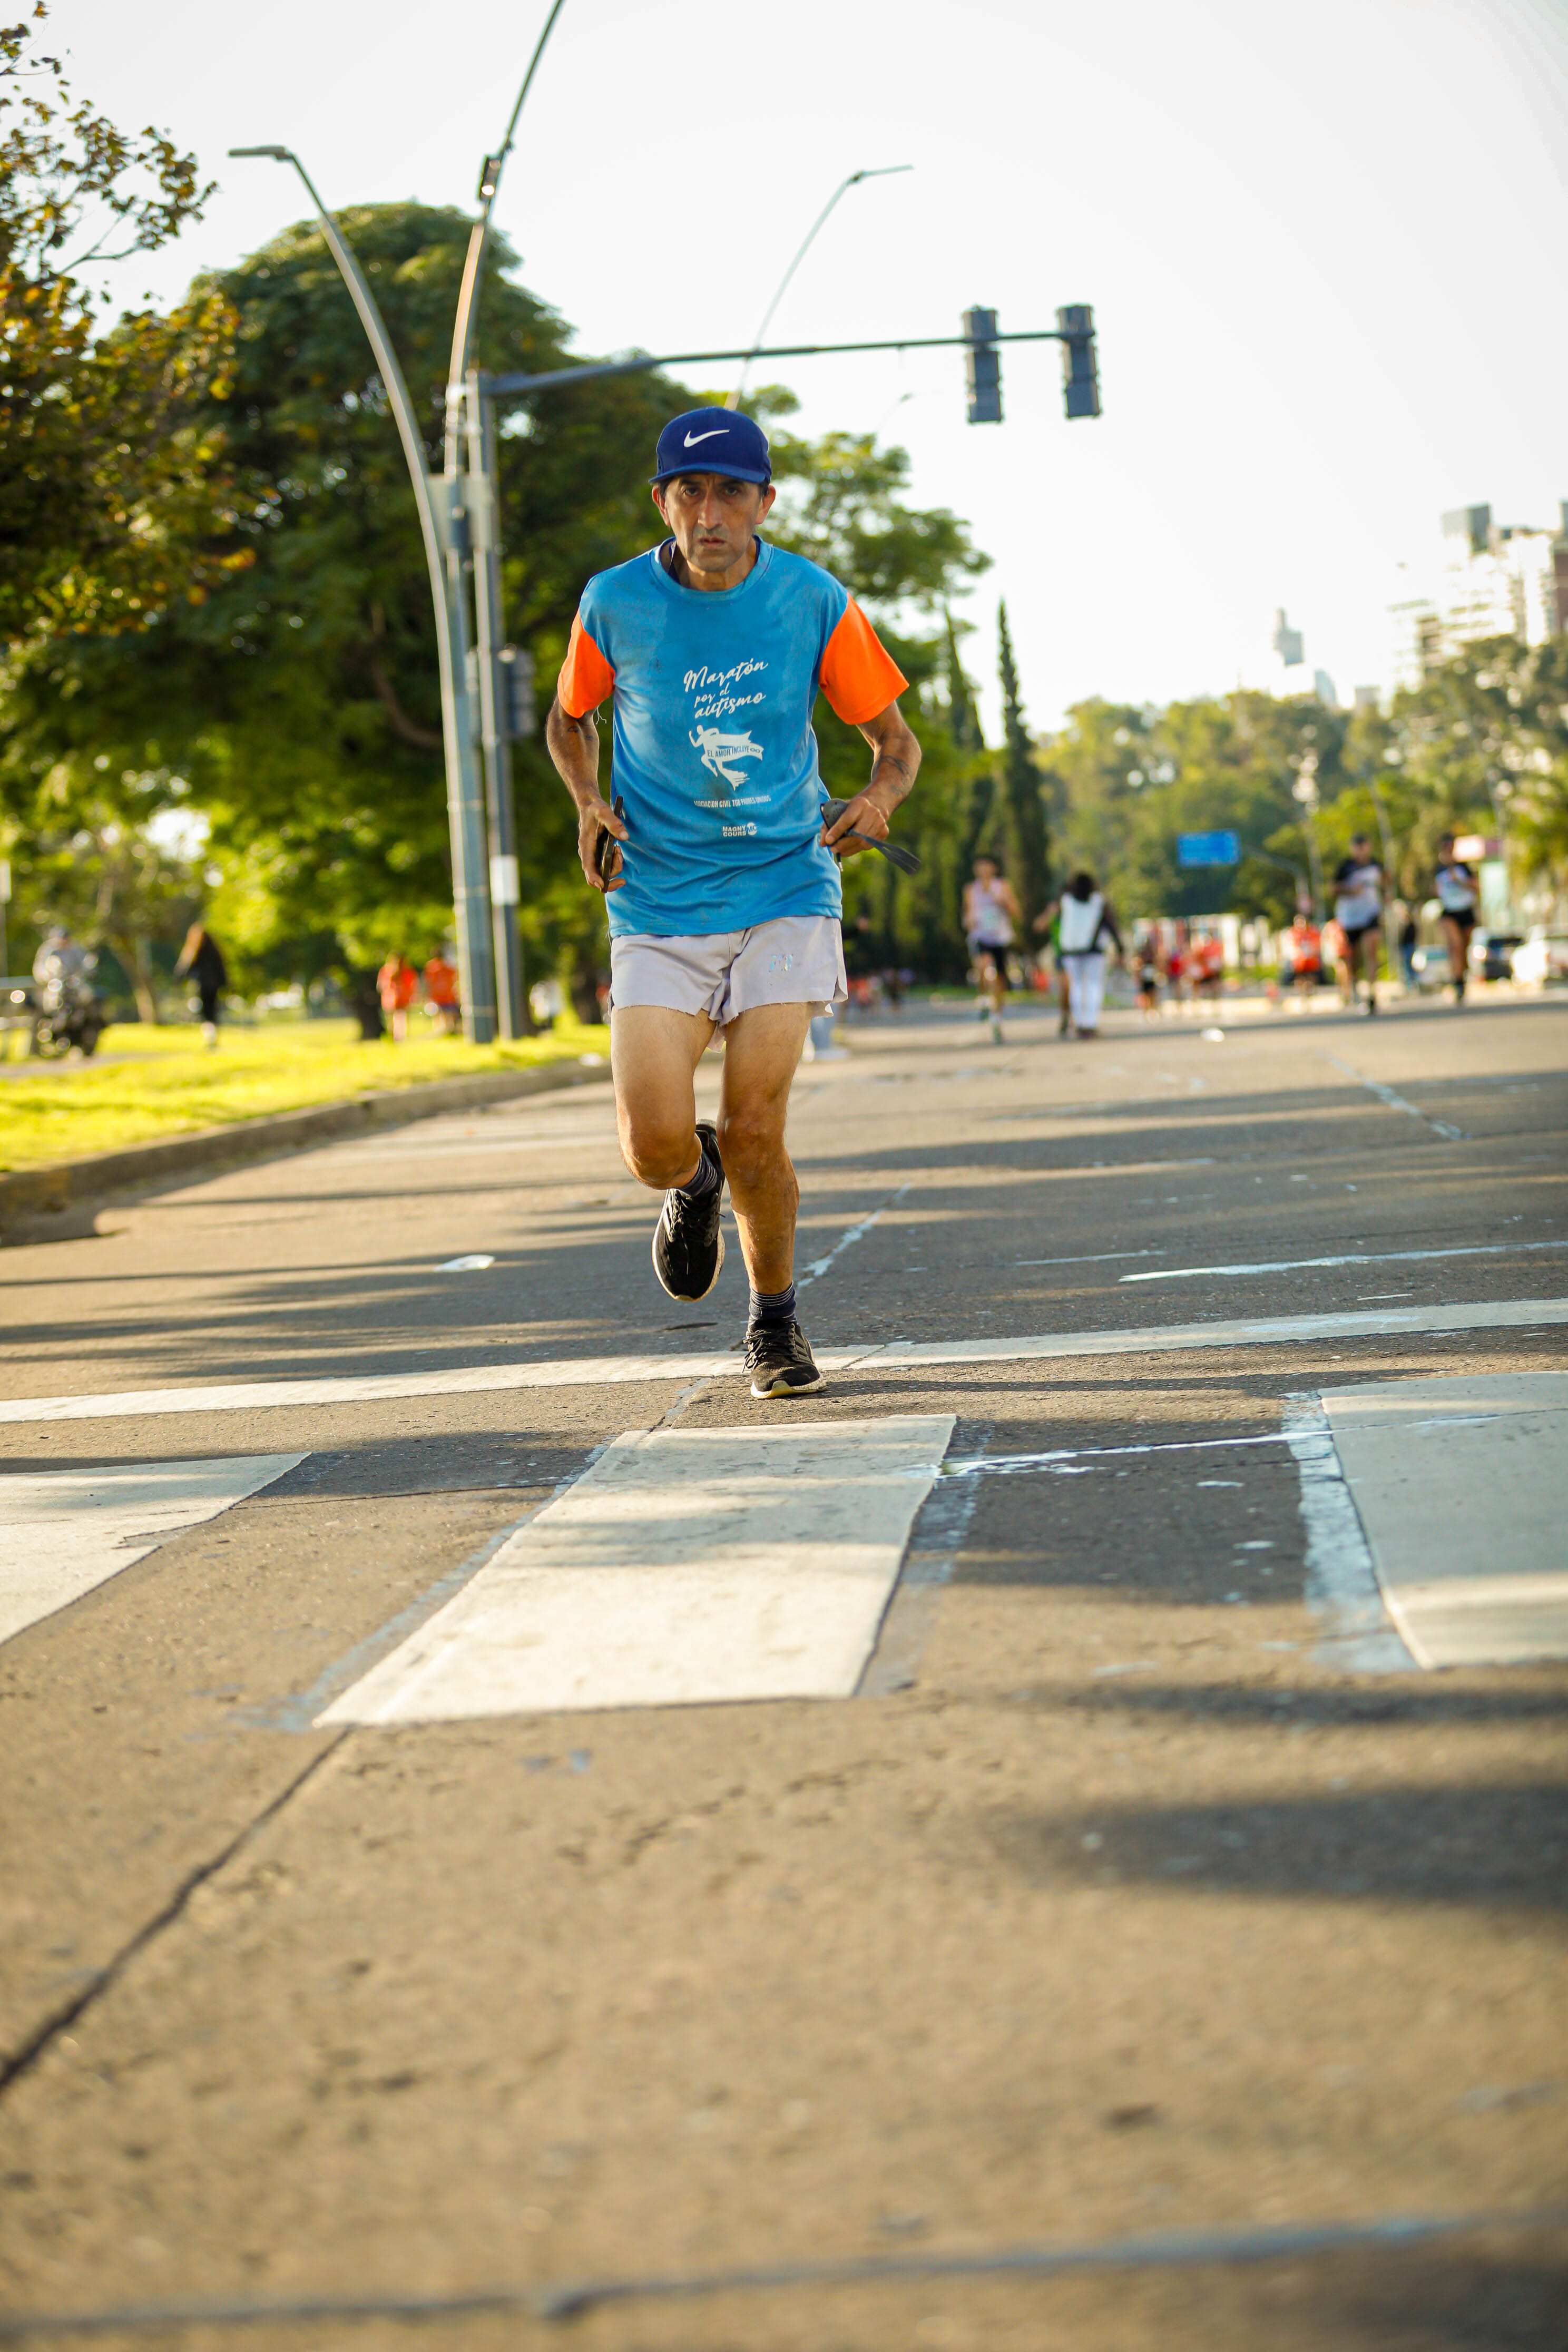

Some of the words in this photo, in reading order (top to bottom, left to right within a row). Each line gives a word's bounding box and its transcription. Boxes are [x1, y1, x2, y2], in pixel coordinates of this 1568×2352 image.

[683, 658, 768, 692] Maratón
[694, 693, 716, 708] por
[719, 682, 730, 695] el
[694, 692, 766, 718] autismo
[715, 748, 730, 758] AMOR
[731, 746, 749, 754] INCLUYE
[719, 799, 731, 808] CIVIL
